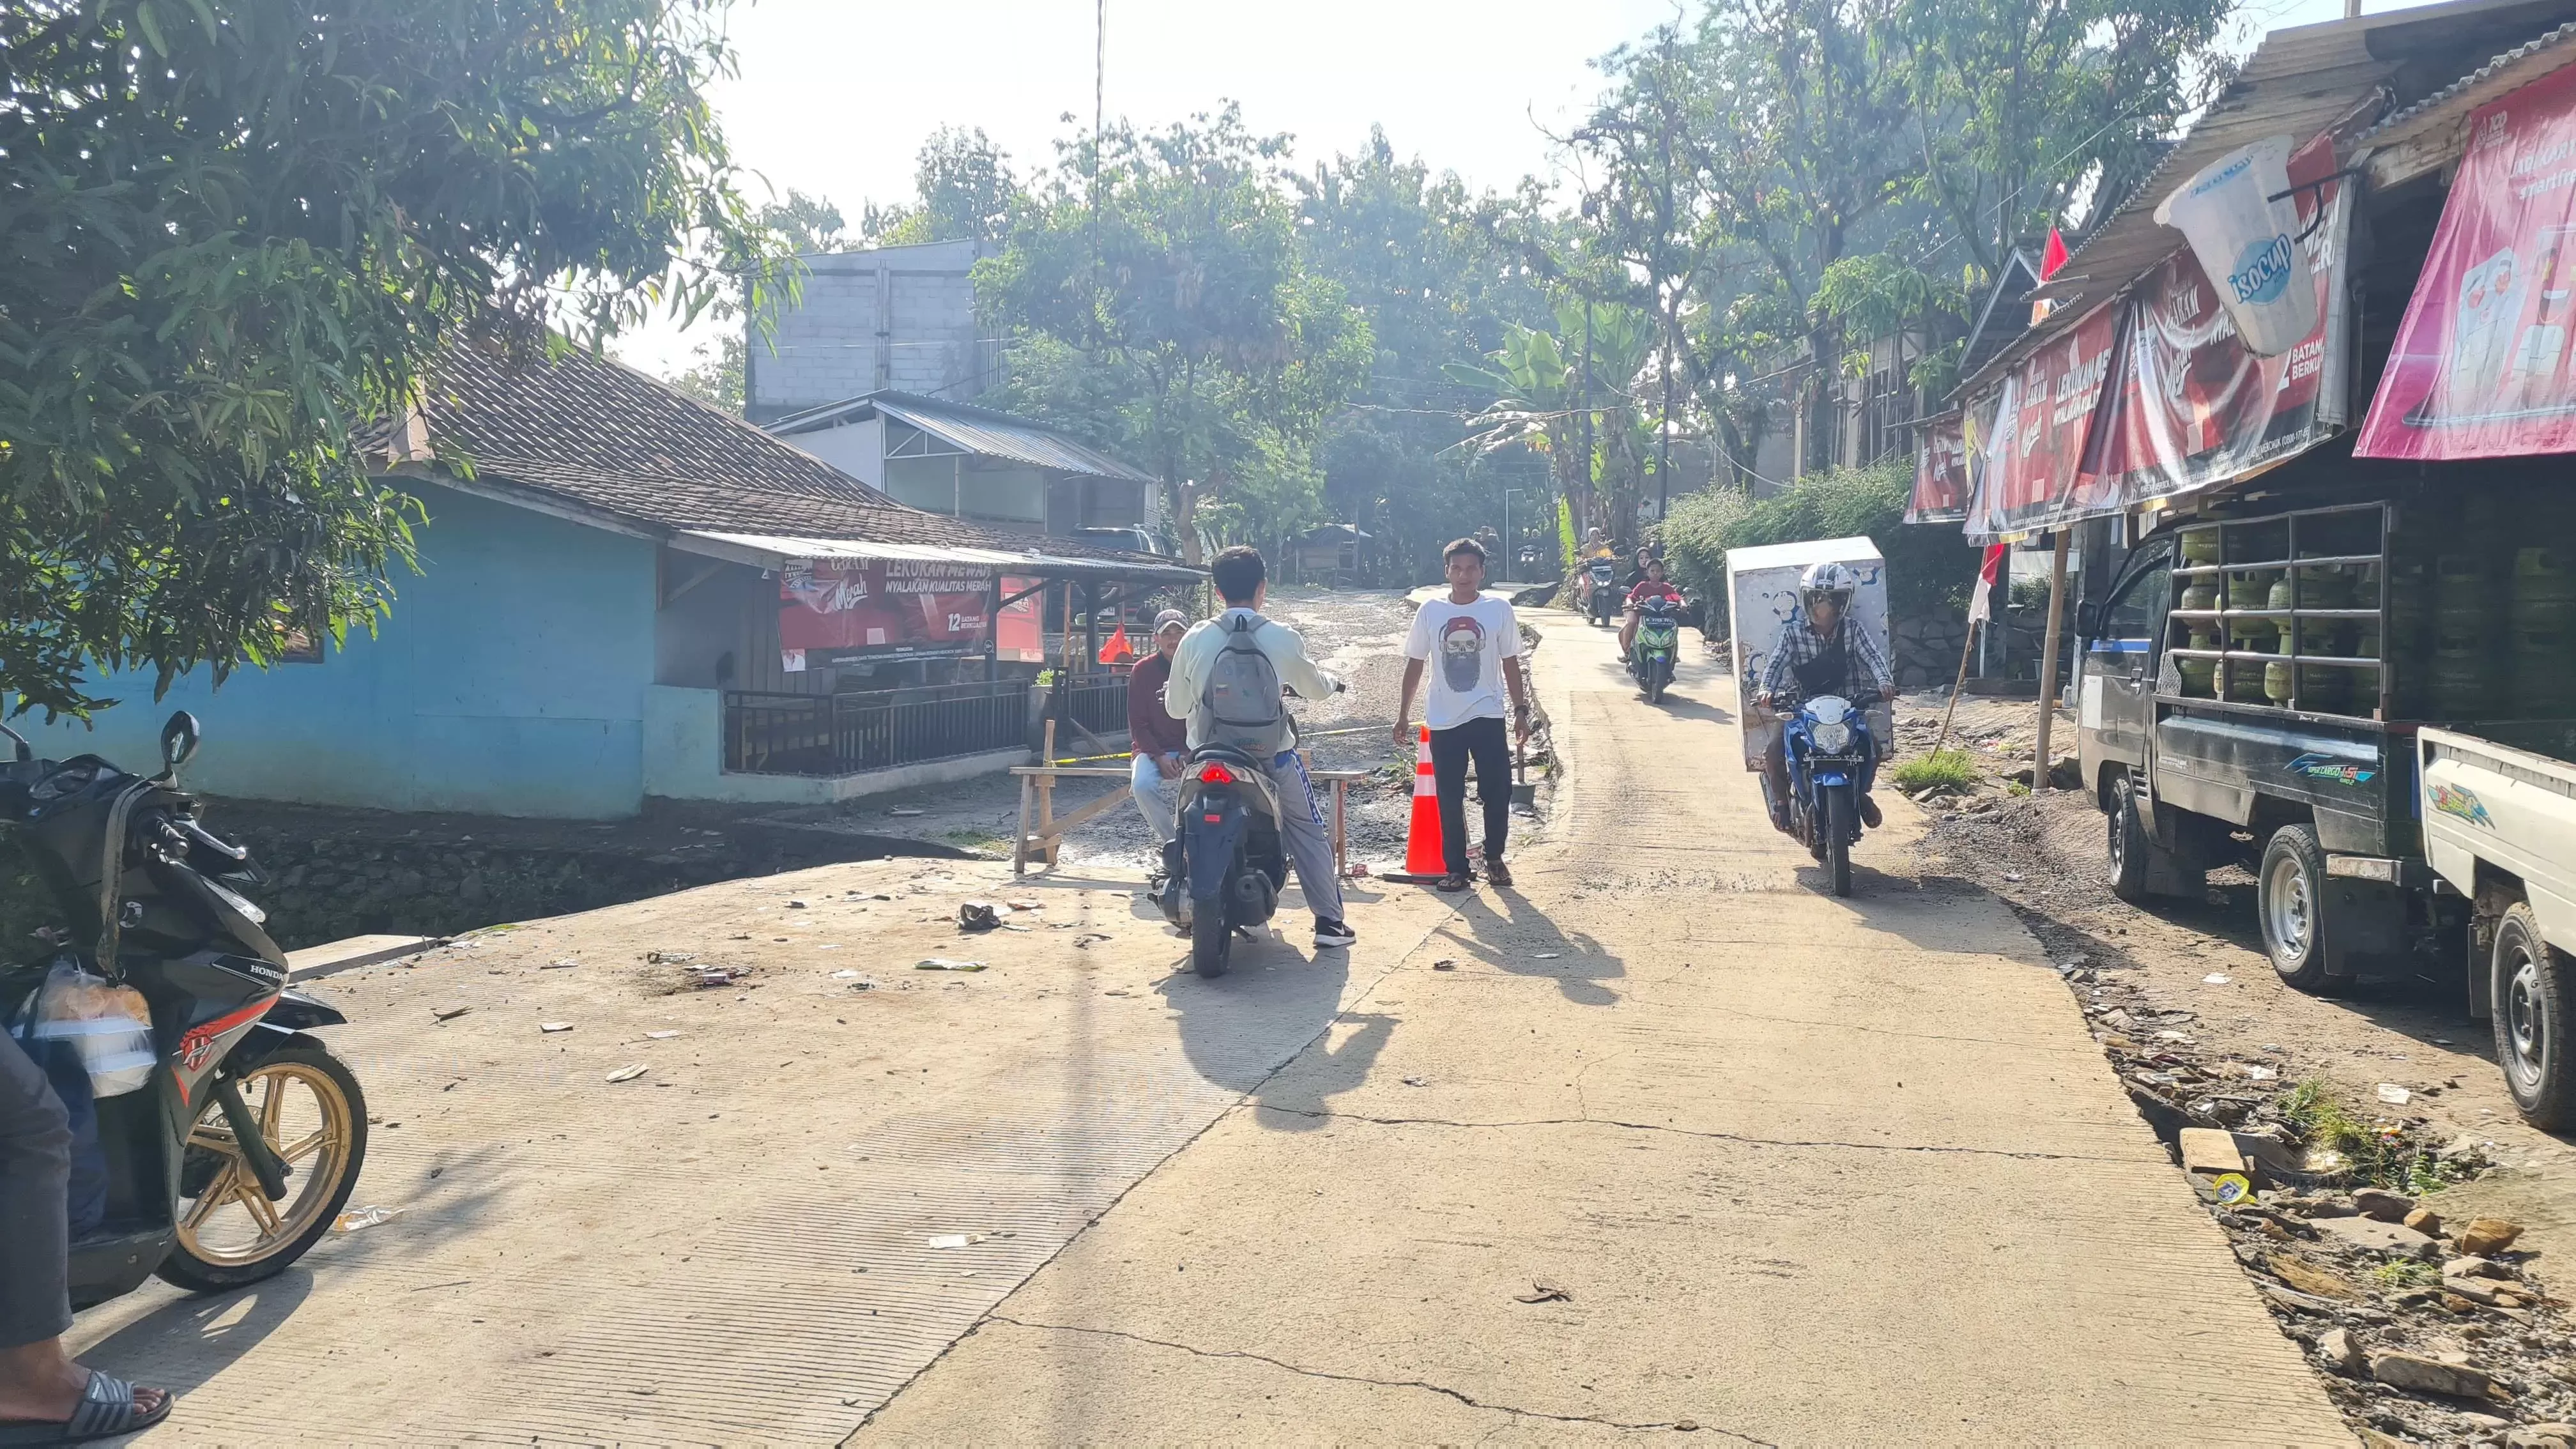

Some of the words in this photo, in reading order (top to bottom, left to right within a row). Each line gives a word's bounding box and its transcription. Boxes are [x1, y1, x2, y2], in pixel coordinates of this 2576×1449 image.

[885, 560, 944, 577] LEKUKAN
[836, 573, 868, 610] Merah
[885, 580, 928, 593] NYALAKAN
[928, 579, 965, 593] KUALITAS
[966, 580, 992, 592] MERAH
[948, 613, 961, 631] 12
[2320, 767, 2341, 777] CARGO
[250, 965, 284, 982] HONDA
